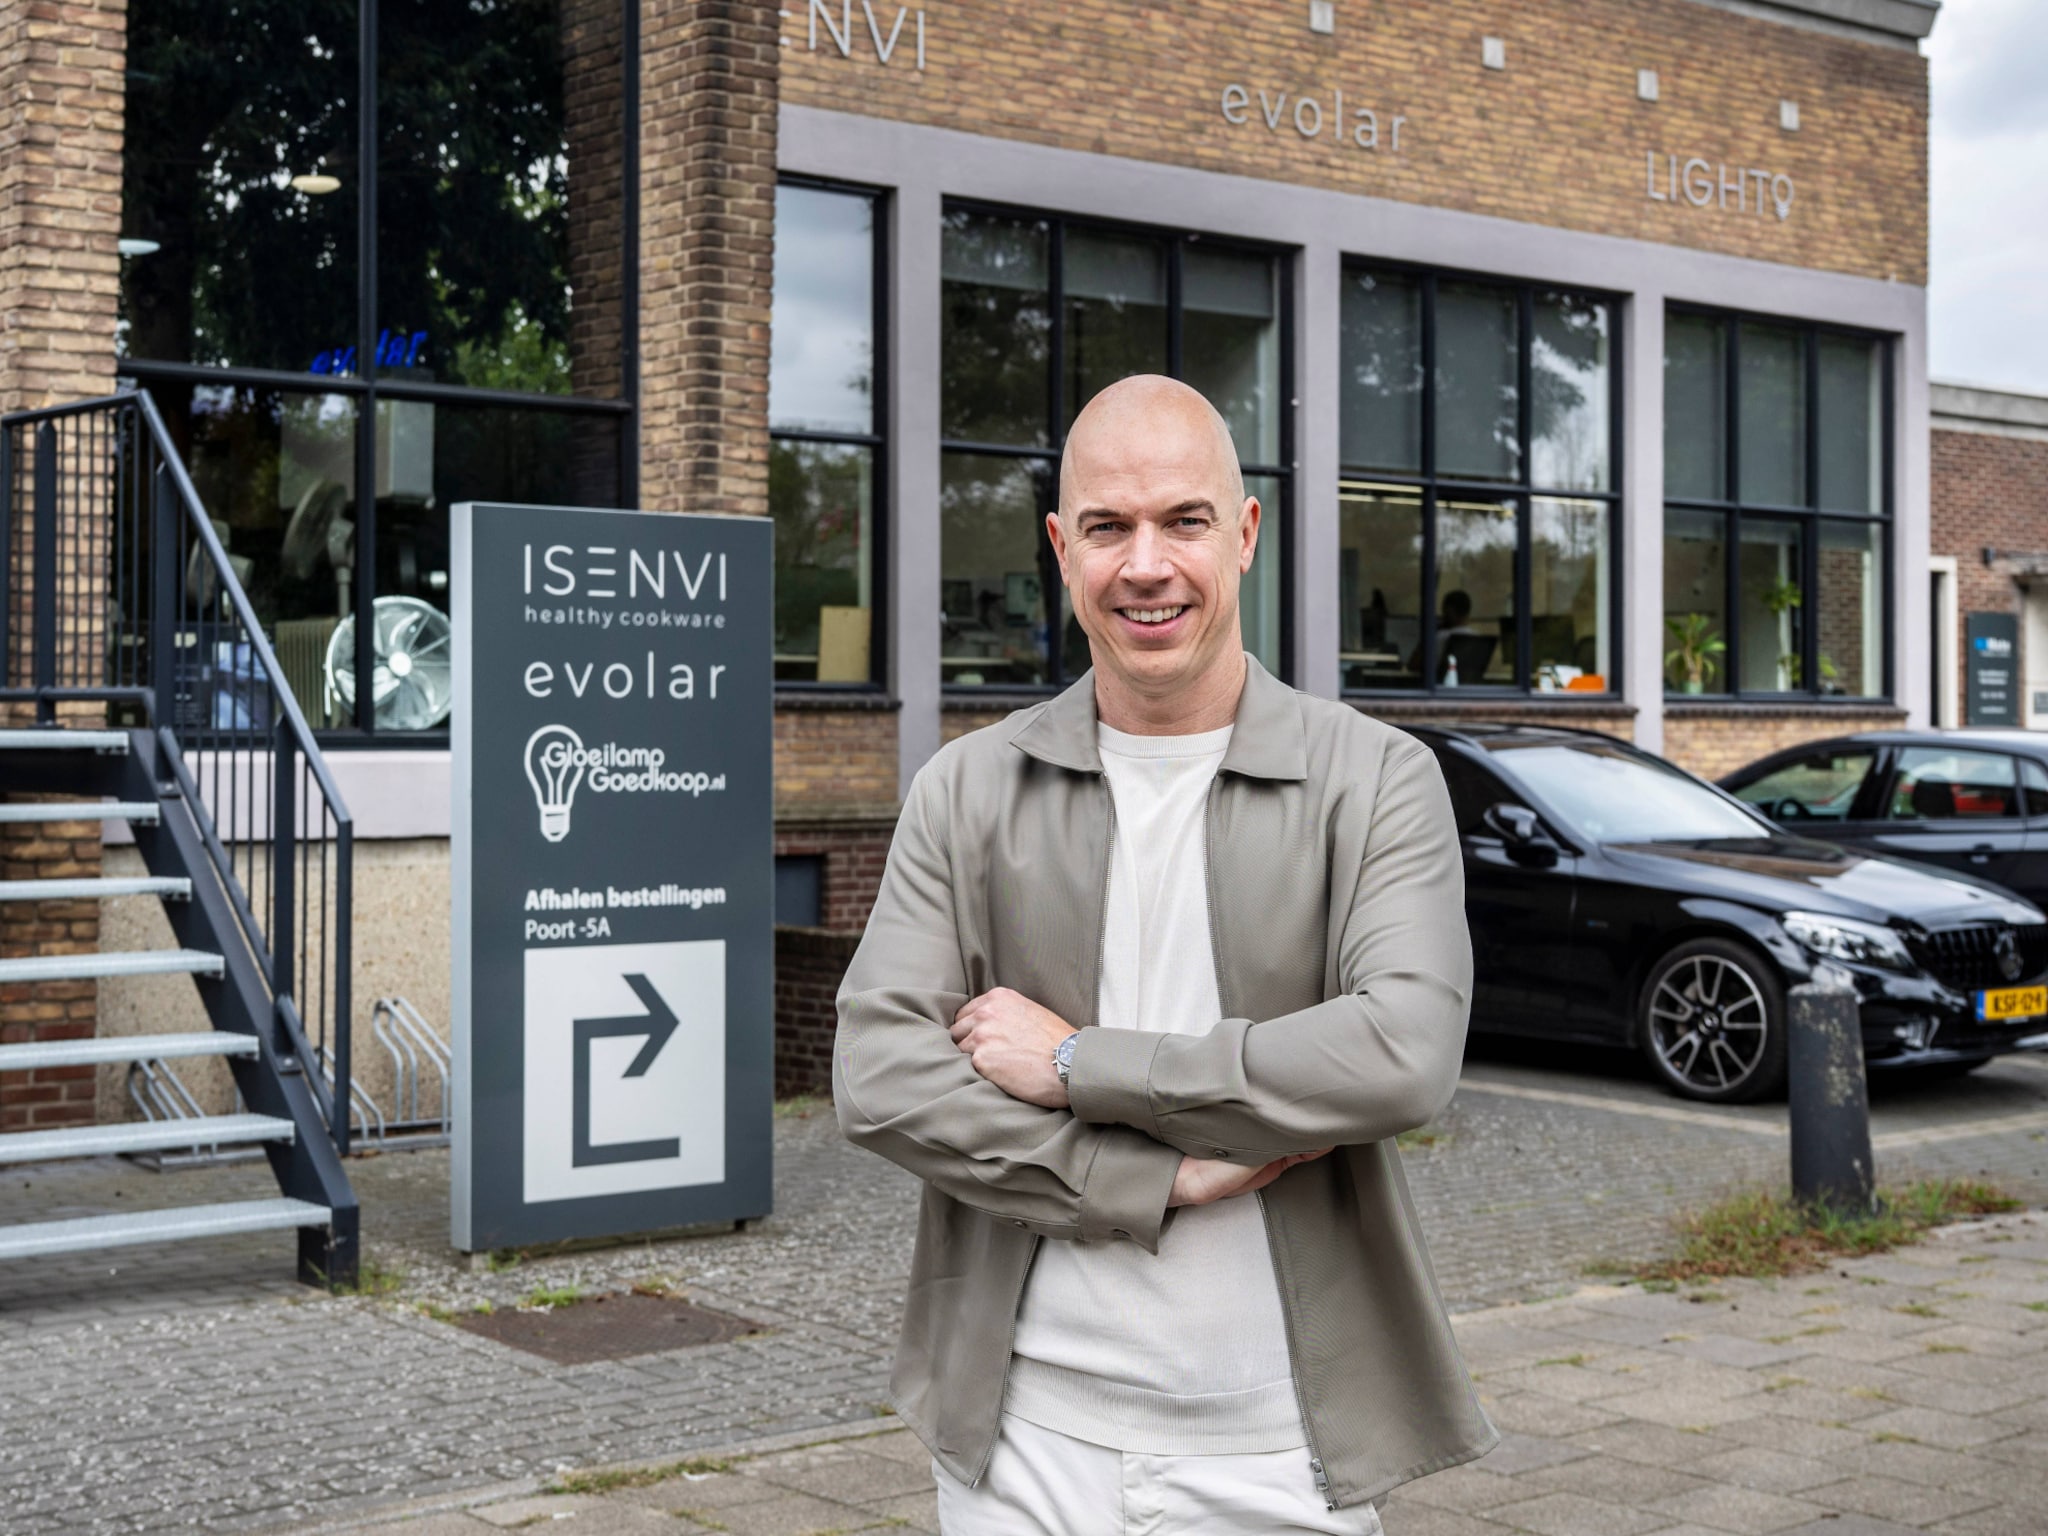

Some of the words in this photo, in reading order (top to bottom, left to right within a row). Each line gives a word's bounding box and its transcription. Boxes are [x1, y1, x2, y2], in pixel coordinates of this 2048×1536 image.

[1221, 84, 1407, 151] evolar
[309, 327, 428, 376] evlar
[524, 544, 727, 601] ISENVI
[525, 605, 614, 629] healthy
[619, 609, 726, 629] cookware
[524, 651, 726, 700] evolar
[544, 741, 665, 769] Gloeilamp
[525, 887, 604, 911] Afhalen
[606, 884, 726, 910] bestellingen
[525, 919, 576, 940] Poort
